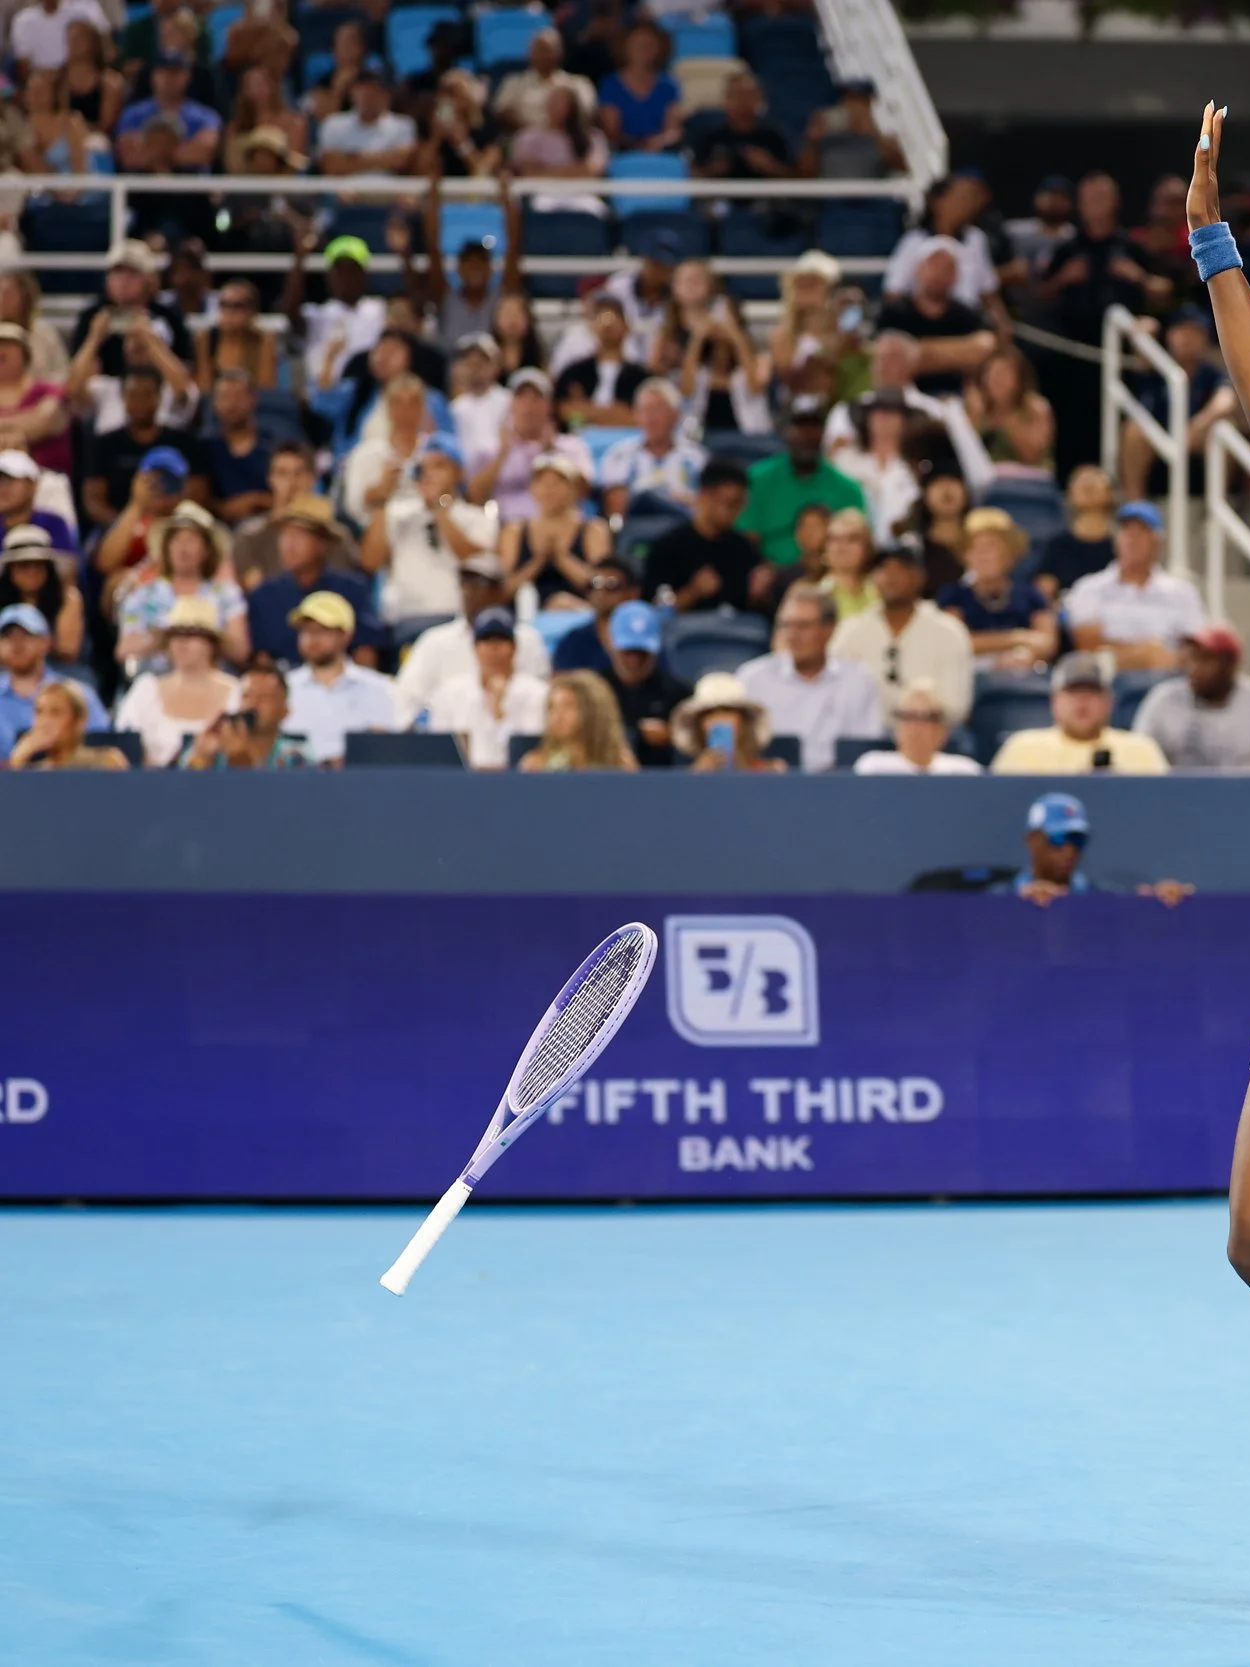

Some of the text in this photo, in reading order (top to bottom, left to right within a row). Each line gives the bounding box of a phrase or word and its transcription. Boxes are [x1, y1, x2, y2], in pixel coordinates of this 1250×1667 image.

[547, 1077, 943, 1125] FIFTH THIRD
[678, 1136, 813, 1172] BANK
